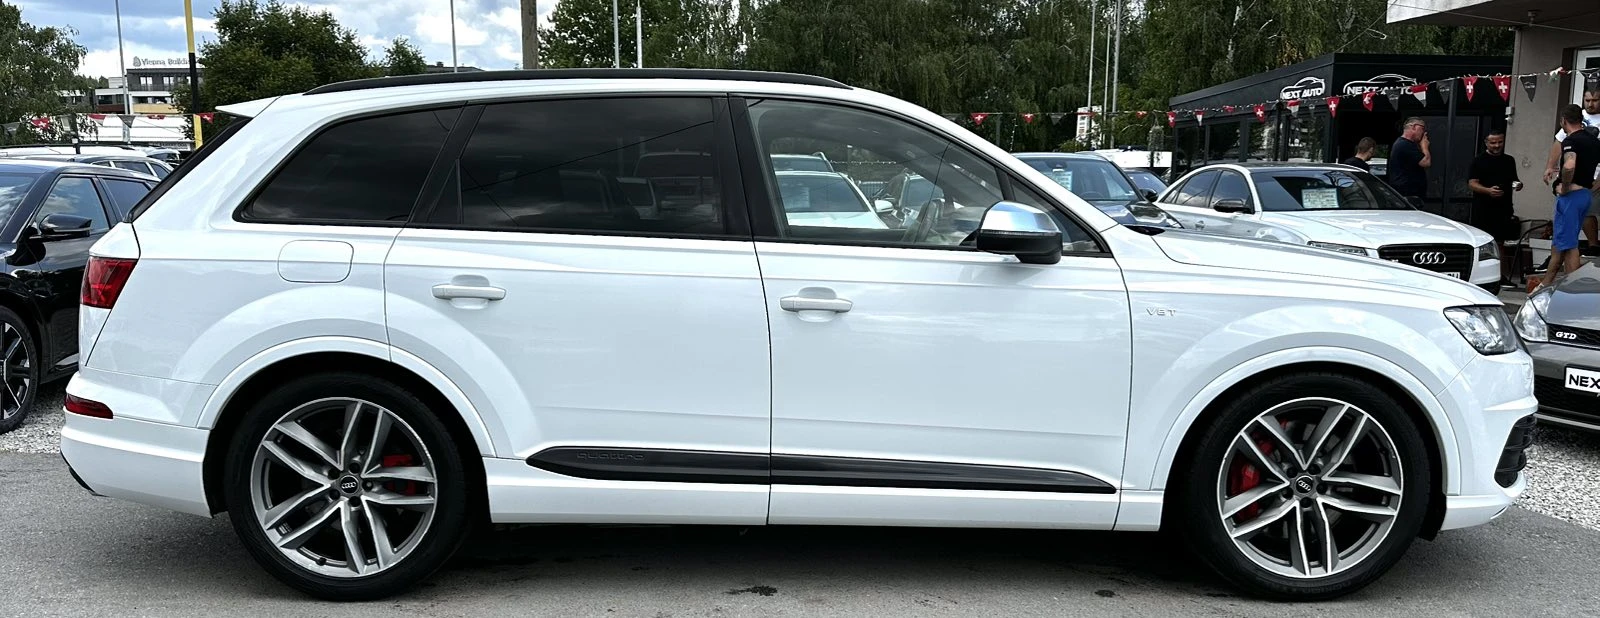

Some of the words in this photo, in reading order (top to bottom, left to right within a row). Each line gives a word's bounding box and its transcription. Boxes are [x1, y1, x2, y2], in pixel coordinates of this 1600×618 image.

[1282, 90, 1301, 100] NEXT
[1301, 88, 1323, 97] AUTO
[1347, 86, 1379, 95] NEXT
[1555, 331, 1577, 340] GTD
[1569, 373, 1600, 390] NEX
[577, 452, 645, 461] quattro
